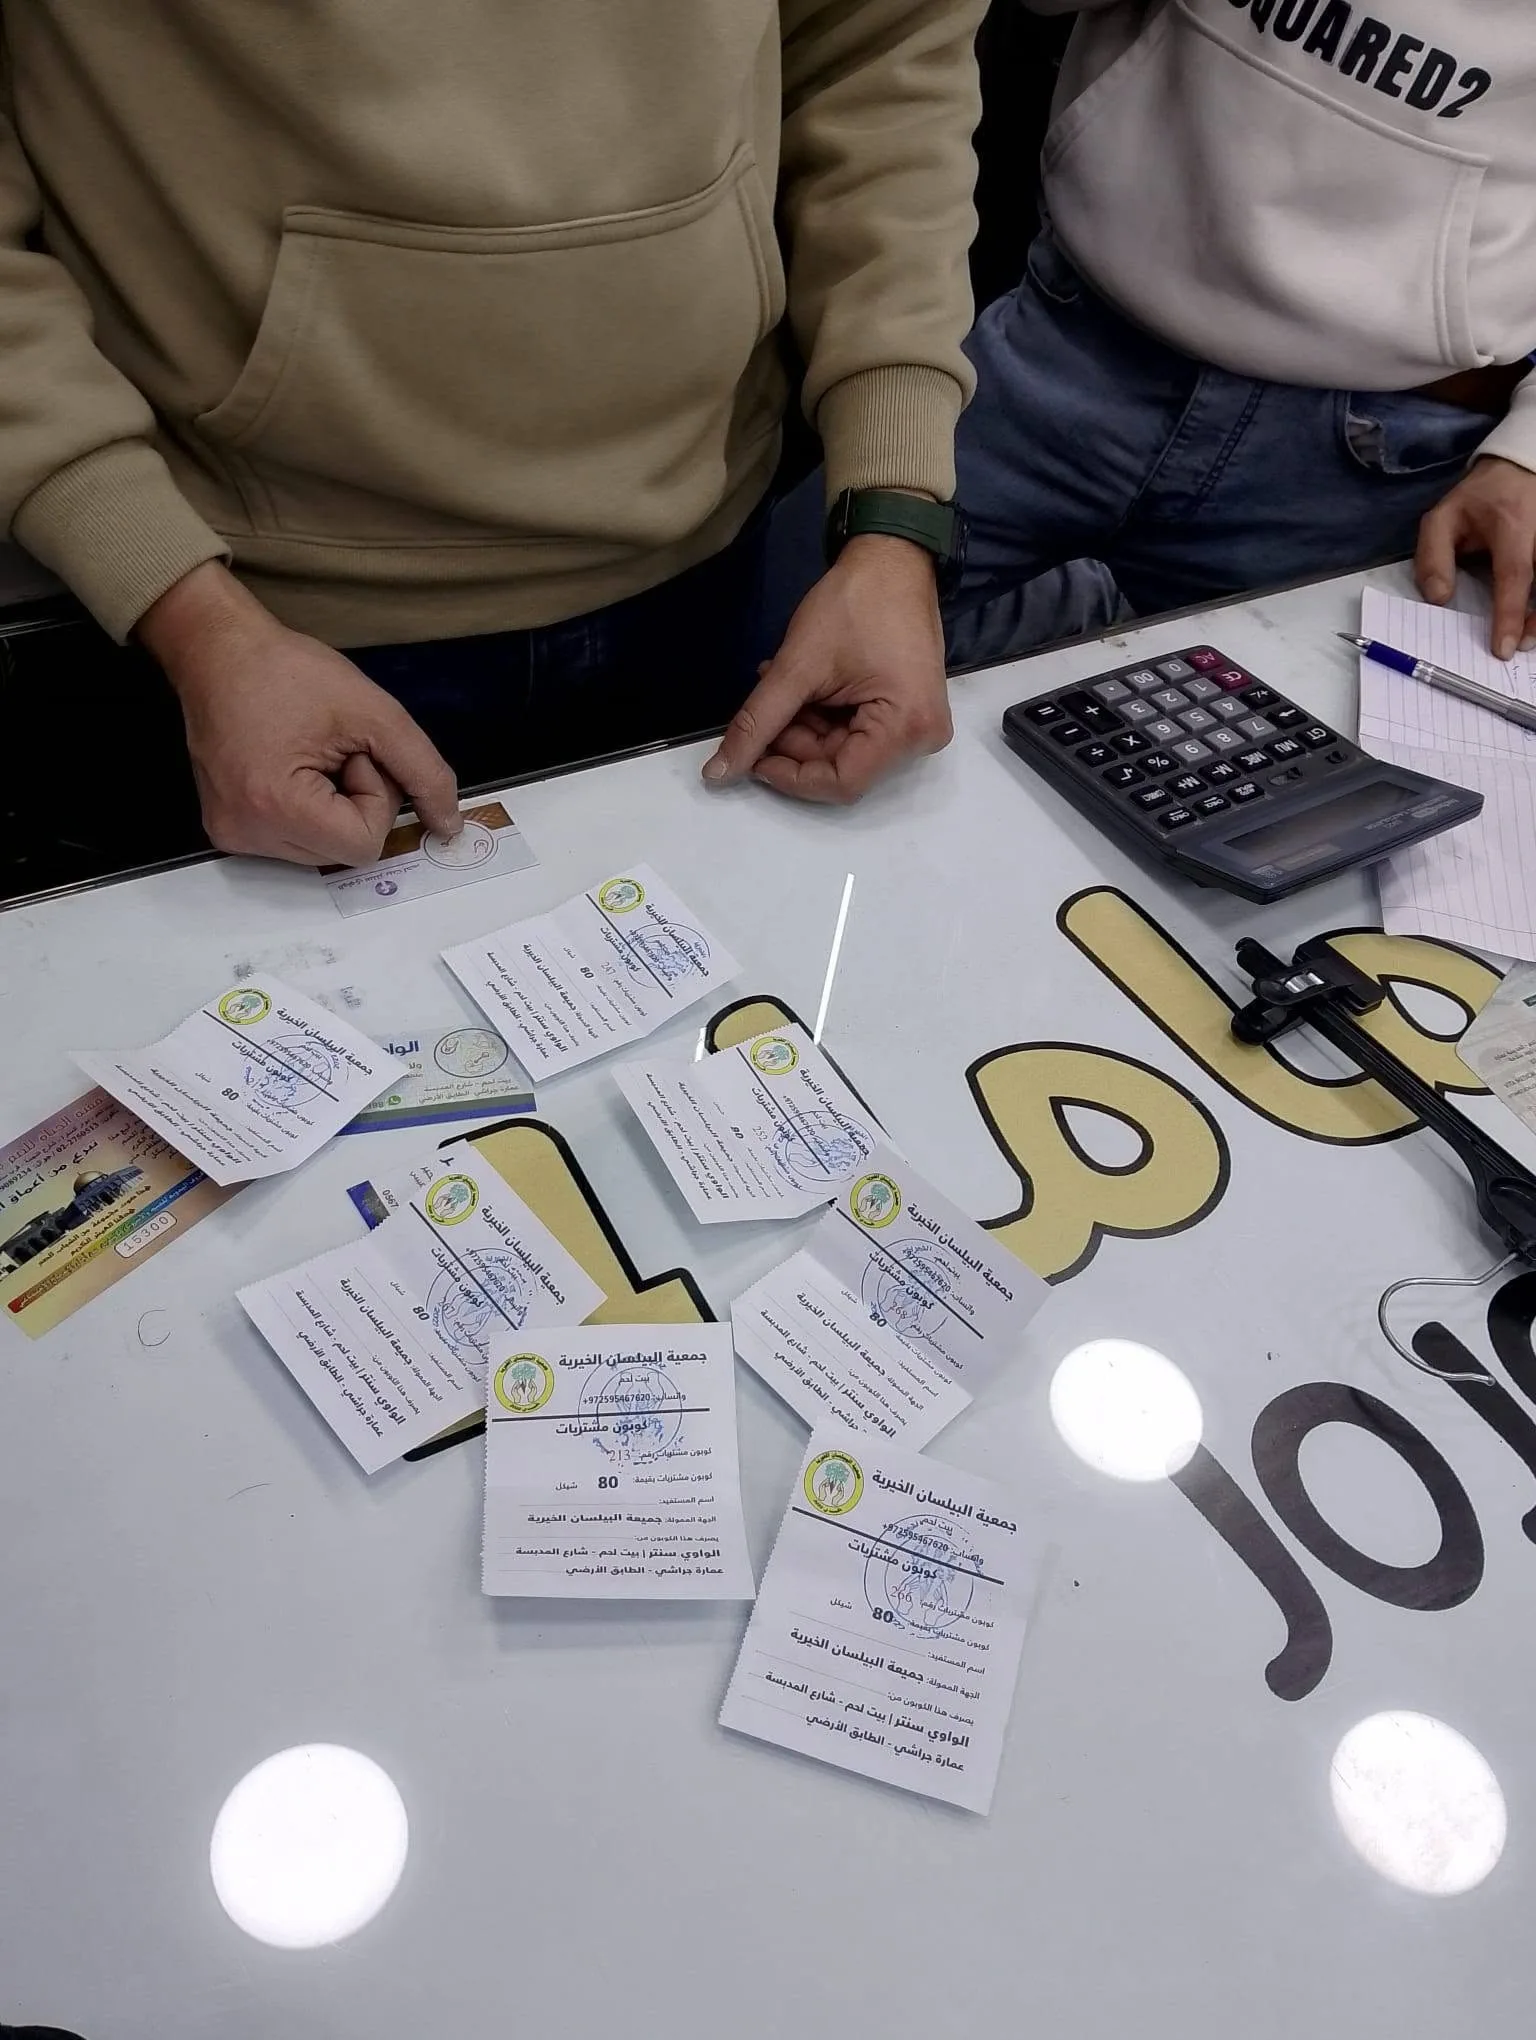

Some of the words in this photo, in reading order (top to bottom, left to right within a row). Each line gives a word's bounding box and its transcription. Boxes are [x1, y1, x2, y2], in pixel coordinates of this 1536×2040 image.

[1228, 0, 1492, 118] QUARED2
[1194, 651, 1216, 664] AC
[1133, 672, 1154, 684] 00
[1221, 670, 1242, 682] CE
[1194, 682, 1207, 692] 1
[1161, 692, 1178, 703] 2
[1130, 703, 1146, 714] 3
[1221, 701, 1235, 712] 4
[1189, 711, 1205, 722] 5
[1157, 724, 1171, 734] 6
[1251, 720, 1265, 731] 7
[1216, 732, 1232, 743] 8
[1305, 727, 1327, 741] GT
[1184, 744, 1199, 754] 9
[1275, 739, 1299, 753] MU
[1177, 775, 1201, 789] M+
[645, 903, 668, 925] الخيرية
[579, 966, 594, 978] 80
[600, 961, 616, 975] 247
[276, 1007, 308, 1029] الخيرية
[381, 1039, 420, 1058] الوا
[344, 1052, 372, 1075] جمعية
[799, 1068, 824, 1095] الخيرية
[221, 1087, 239, 1100] 80
[751, 1087, 776, 1119] مشتريات
[46, 1161, 68, 1178] من
[481, 1205, 510, 1236] الخيرية
[907, 1203, 940, 1235] الخيرية
[122, 1215, 170, 1252] 15300
[504, 1236, 543, 1275] البيلسان
[938, 1233, 983, 1272] البيلسان
[430, 1247, 462, 1285] مشتريات
[868, 1251, 910, 1286] مشتريات
[539, 1271, 564, 1305] جمعية
[982, 1268, 1013, 1301] جمعية
[458, 1283, 484, 1307] كوبون
[905, 1285, 934, 1309] كوبون
[412, 1306, 429, 1320] 80
[869, 1309, 888, 1327] 80
[558, 1353, 601, 1369] الخيرية
[606, 1351, 663, 1367] البيلسان
[666, 1350, 707, 1363] جمعية
[808, 1360, 826, 1371] لحم
[824, 1371, 839, 1387] بيت
[556, 1421, 609, 1436] مشتريات
[612, 1420, 648, 1435] كوبون
[862, 1410, 896, 1438] الواوي
[609, 1449, 631, 1463] 213
[689, 1447, 713, 1456] كوبون
[598, 1475, 619, 1490] 80
[657, 1473, 689, 1484] مشتريات
[690, 1472, 713, 1482] كوبون
[872, 1469, 914, 1495] الخيرية
[555, 1481, 578, 1491] شيكل
[697, 1495, 715, 1505] اسم
[916, 1489, 973, 1517] البيلسان
[527, 1513, 567, 1525] الخيرية
[570, 1512, 623, 1525] البيلسان
[975, 1508, 1016, 1535] جمعية
[563, 1547, 589, 1559] شارع
[598, 1548, 617, 1558] لحم
[620, 1549, 640, 1559] بيت
[649, 1548, 677, 1559] سنتر
[680, 1548, 721, 1561] الواوي
[848, 1539, 898, 1565] مشتريات
[565, 1564, 607, 1577] الأرضي
[610, 1565, 645, 1576] الطابق
[695, 1565, 725, 1575] عمارة
[901, 1560, 937, 1579] كوبون
[889, 1585, 913, 1602] 266
[830, 1597, 852, 1609] شيكل
[872, 1607, 893, 1623] 80
[971, 1616, 994, 1627] كوبون
[790, 1627, 829, 1649] الخيرية
[966, 1639, 989, 1650] كوبون
[831, 1644, 884, 1668] البيلسان
[886, 1660, 923, 1684] جميعة
[966, 1666, 985, 1674] اسم
[809, 1690, 835, 1703] شارع
[959, 1687, 980, 1699] الجهة
[844, 1703, 864, 1713] لحم
[866, 1706, 886, 1723] بيت
[933, 1705, 947, 1716] هذا
[805, 1715, 847, 1732] الأرضي
[893, 1715, 924, 1732] سنتر
[848, 1726, 884, 1745] الطابق
[927, 1730, 969, 1747] الواوي
[935, 1754, 963, 1771] عمارة
